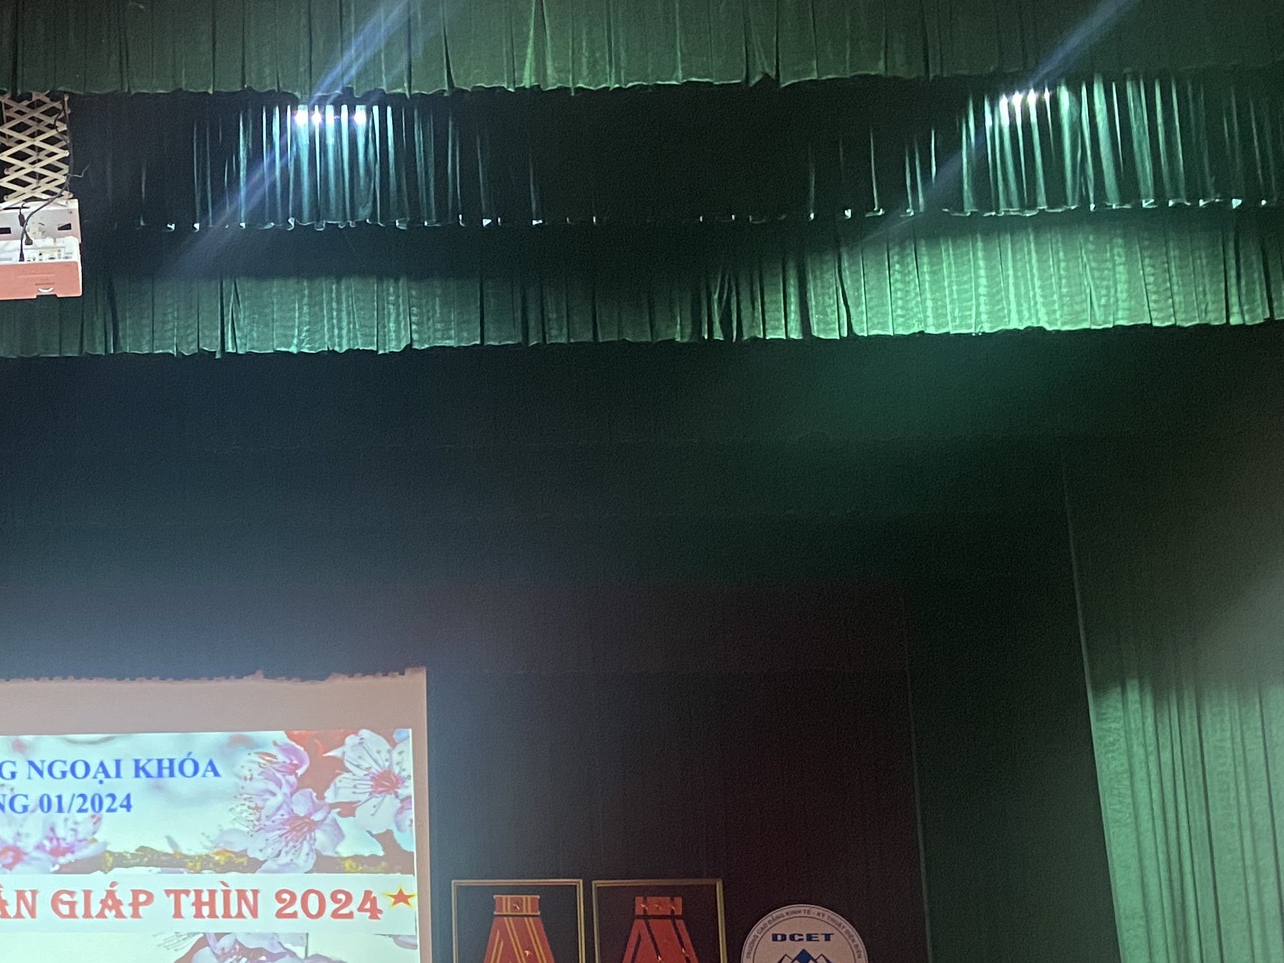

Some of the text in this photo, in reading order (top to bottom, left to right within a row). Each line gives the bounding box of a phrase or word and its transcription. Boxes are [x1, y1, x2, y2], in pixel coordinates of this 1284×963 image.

[27, 759, 123, 785] NGOẠI
[133, 752, 222, 779] KHÓA
[38, 793, 133, 814] 01/2024
[50, 881, 154, 919] GIÁP
[164, 880, 260, 919] THÌN
[274, 888, 384, 920] 2024
[771, 932, 834, 942] DCET
